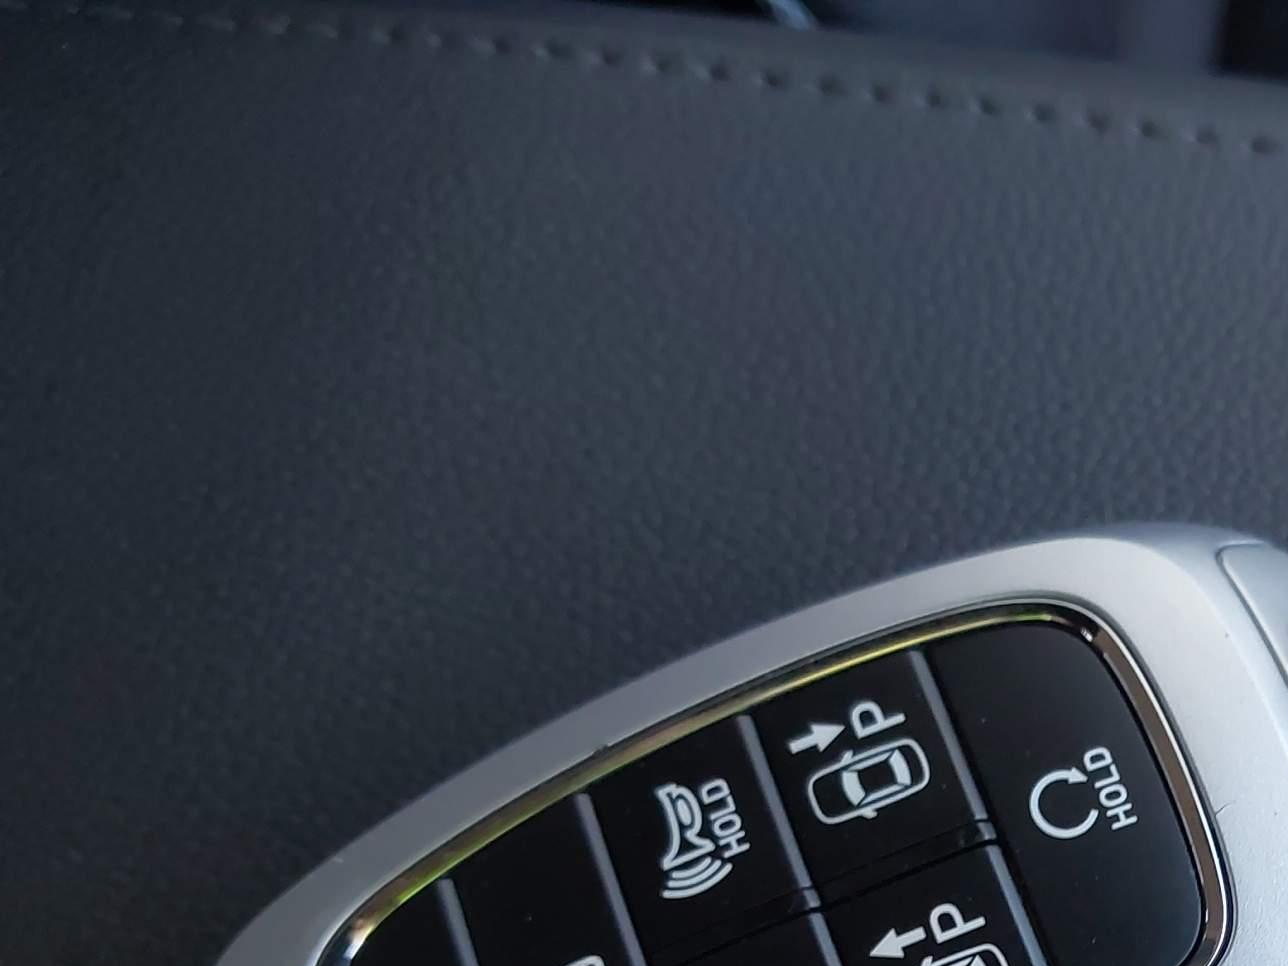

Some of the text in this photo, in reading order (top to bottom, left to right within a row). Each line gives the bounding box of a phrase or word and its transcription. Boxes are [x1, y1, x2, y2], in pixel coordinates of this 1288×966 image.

[849, 701, 906, 739] P
[701, 778, 750, 859] HOLD
[1083, 746, 1138, 831] HOLD
[929, 903, 986, 943] P
